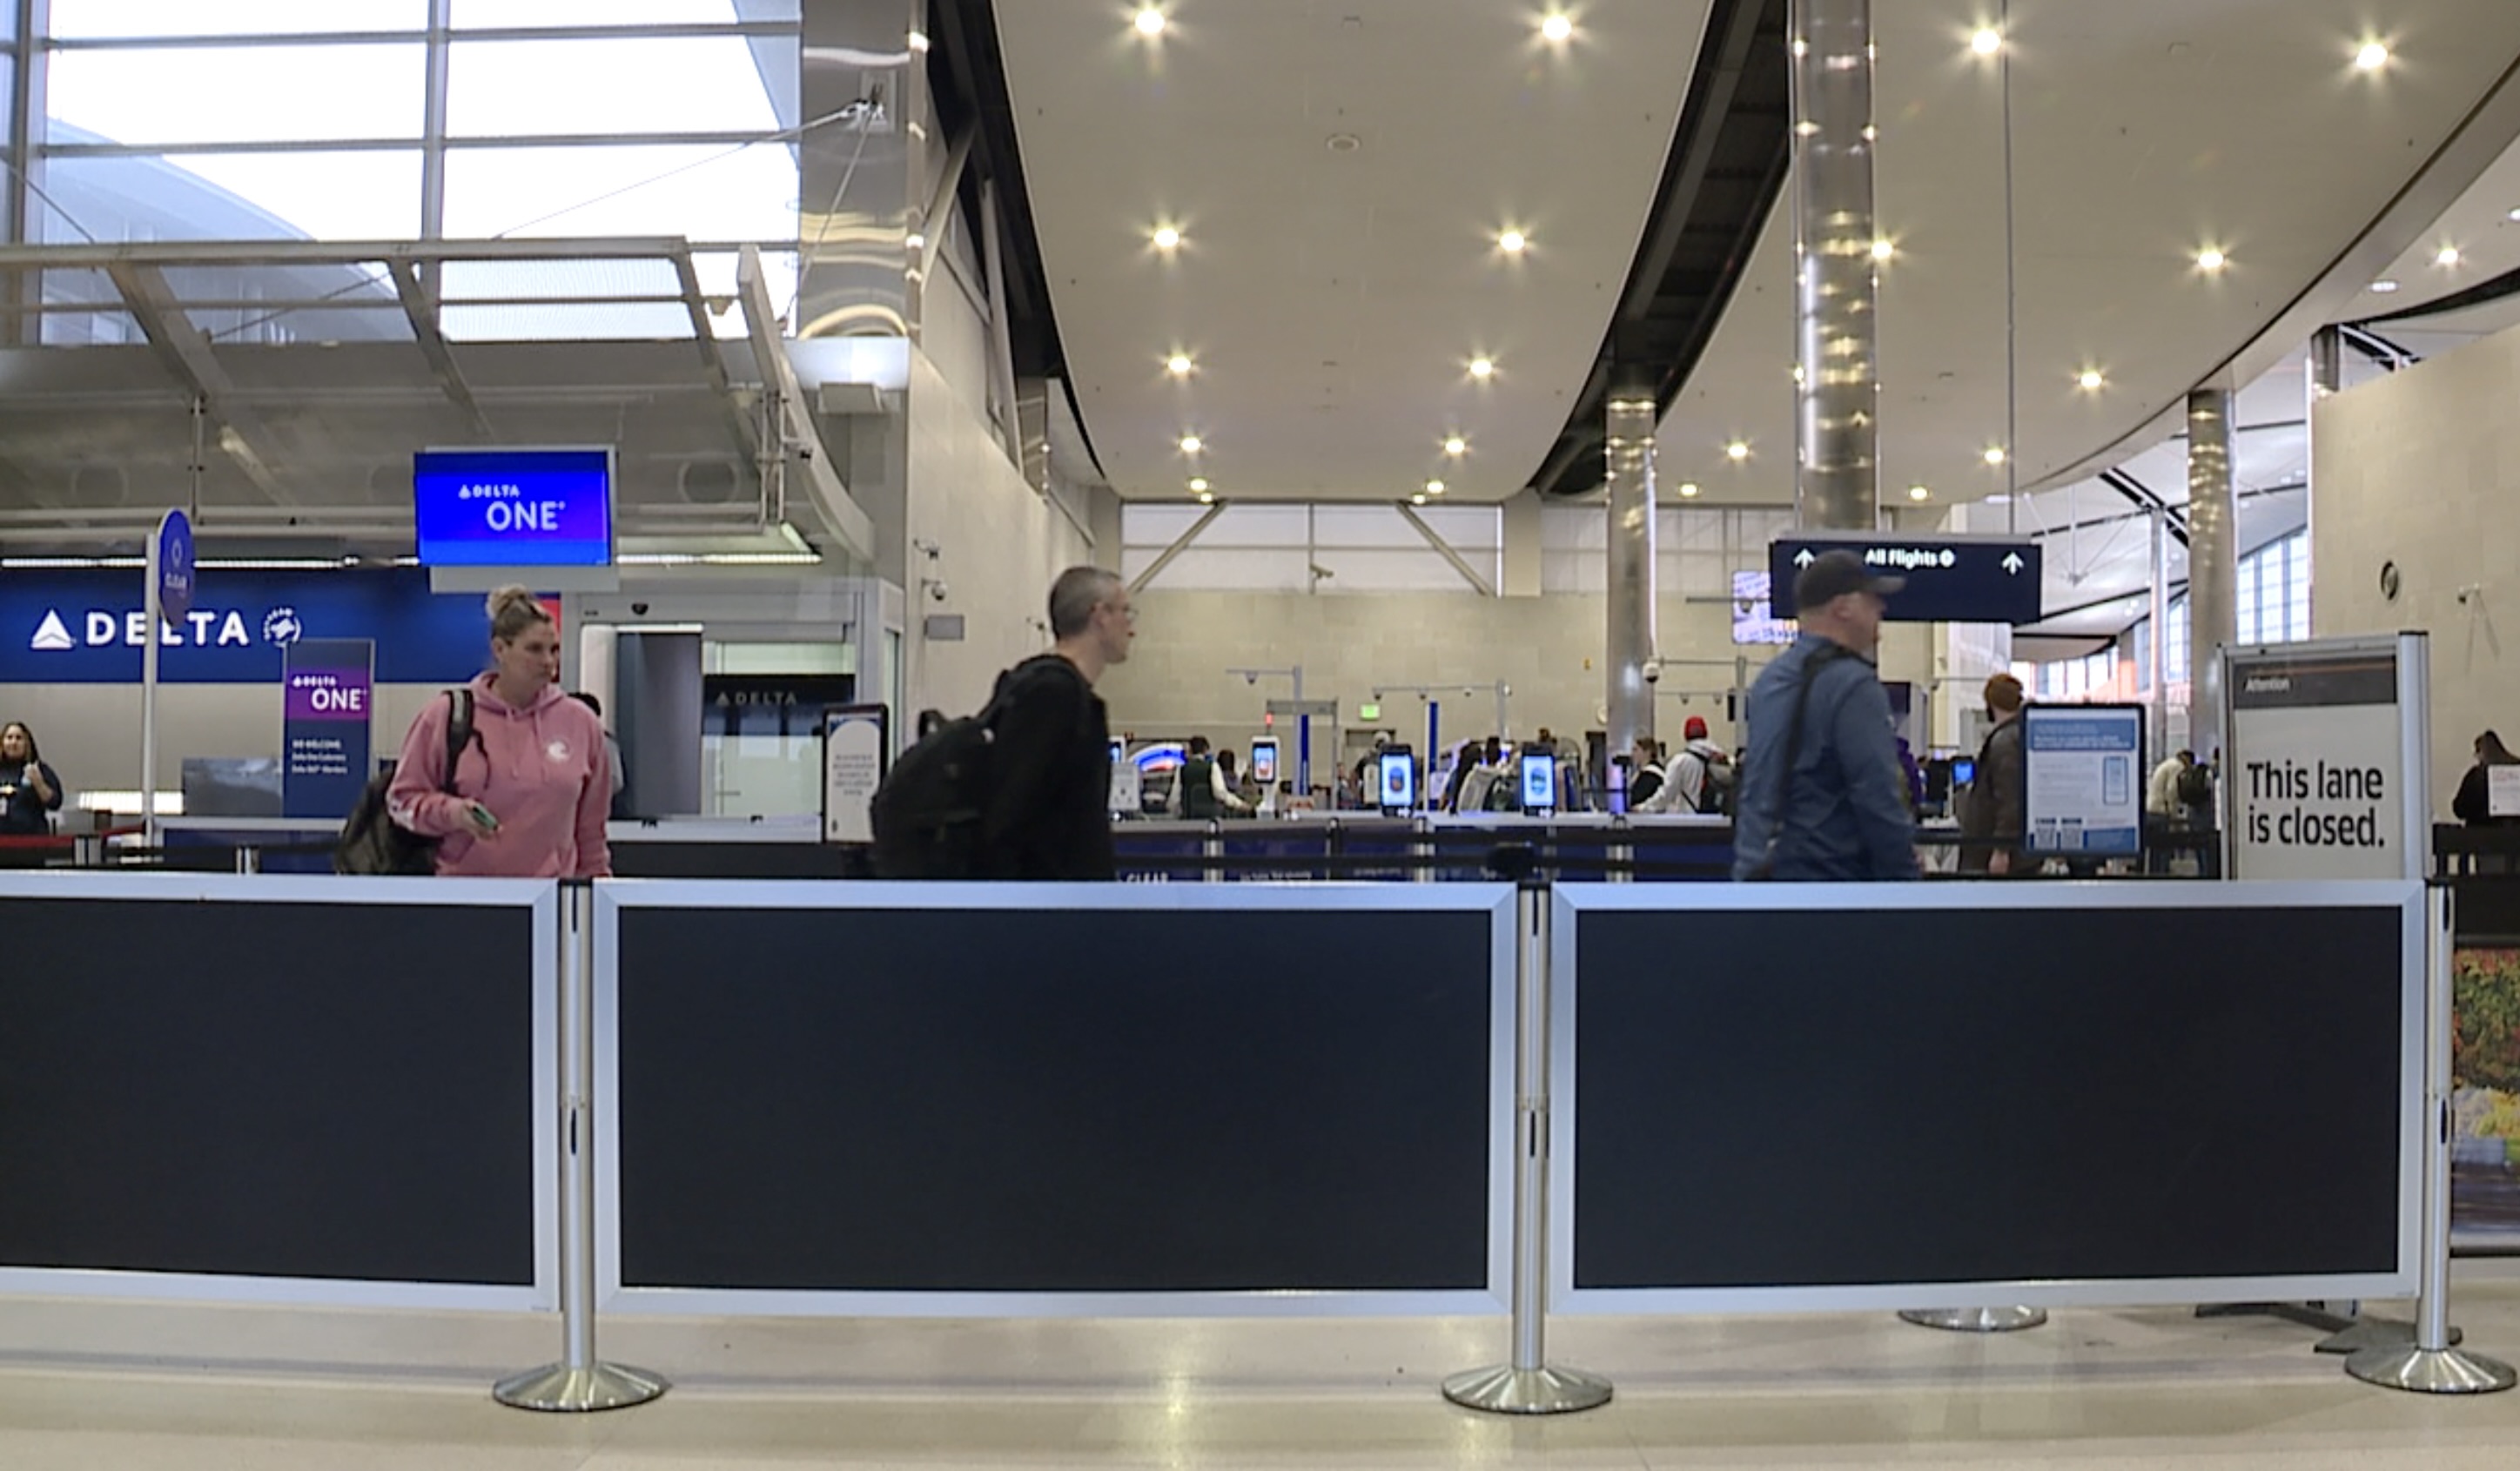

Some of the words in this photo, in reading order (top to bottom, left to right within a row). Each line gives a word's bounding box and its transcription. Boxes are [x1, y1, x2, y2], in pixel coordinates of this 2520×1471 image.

[473, 484, 521, 498] DELTA
[487, 500, 559, 531] ONE
[1865, 548, 1886, 566] All
[1888, 548, 1938, 570] Flights
[312, 688, 362, 710] ONE
[736, 692, 796, 706] DELTA
[2247, 759, 2308, 799] This
[2318, 760, 2383, 799] lane
[2249, 804, 2270, 843] is
[2278, 806, 2384, 848] closed.
